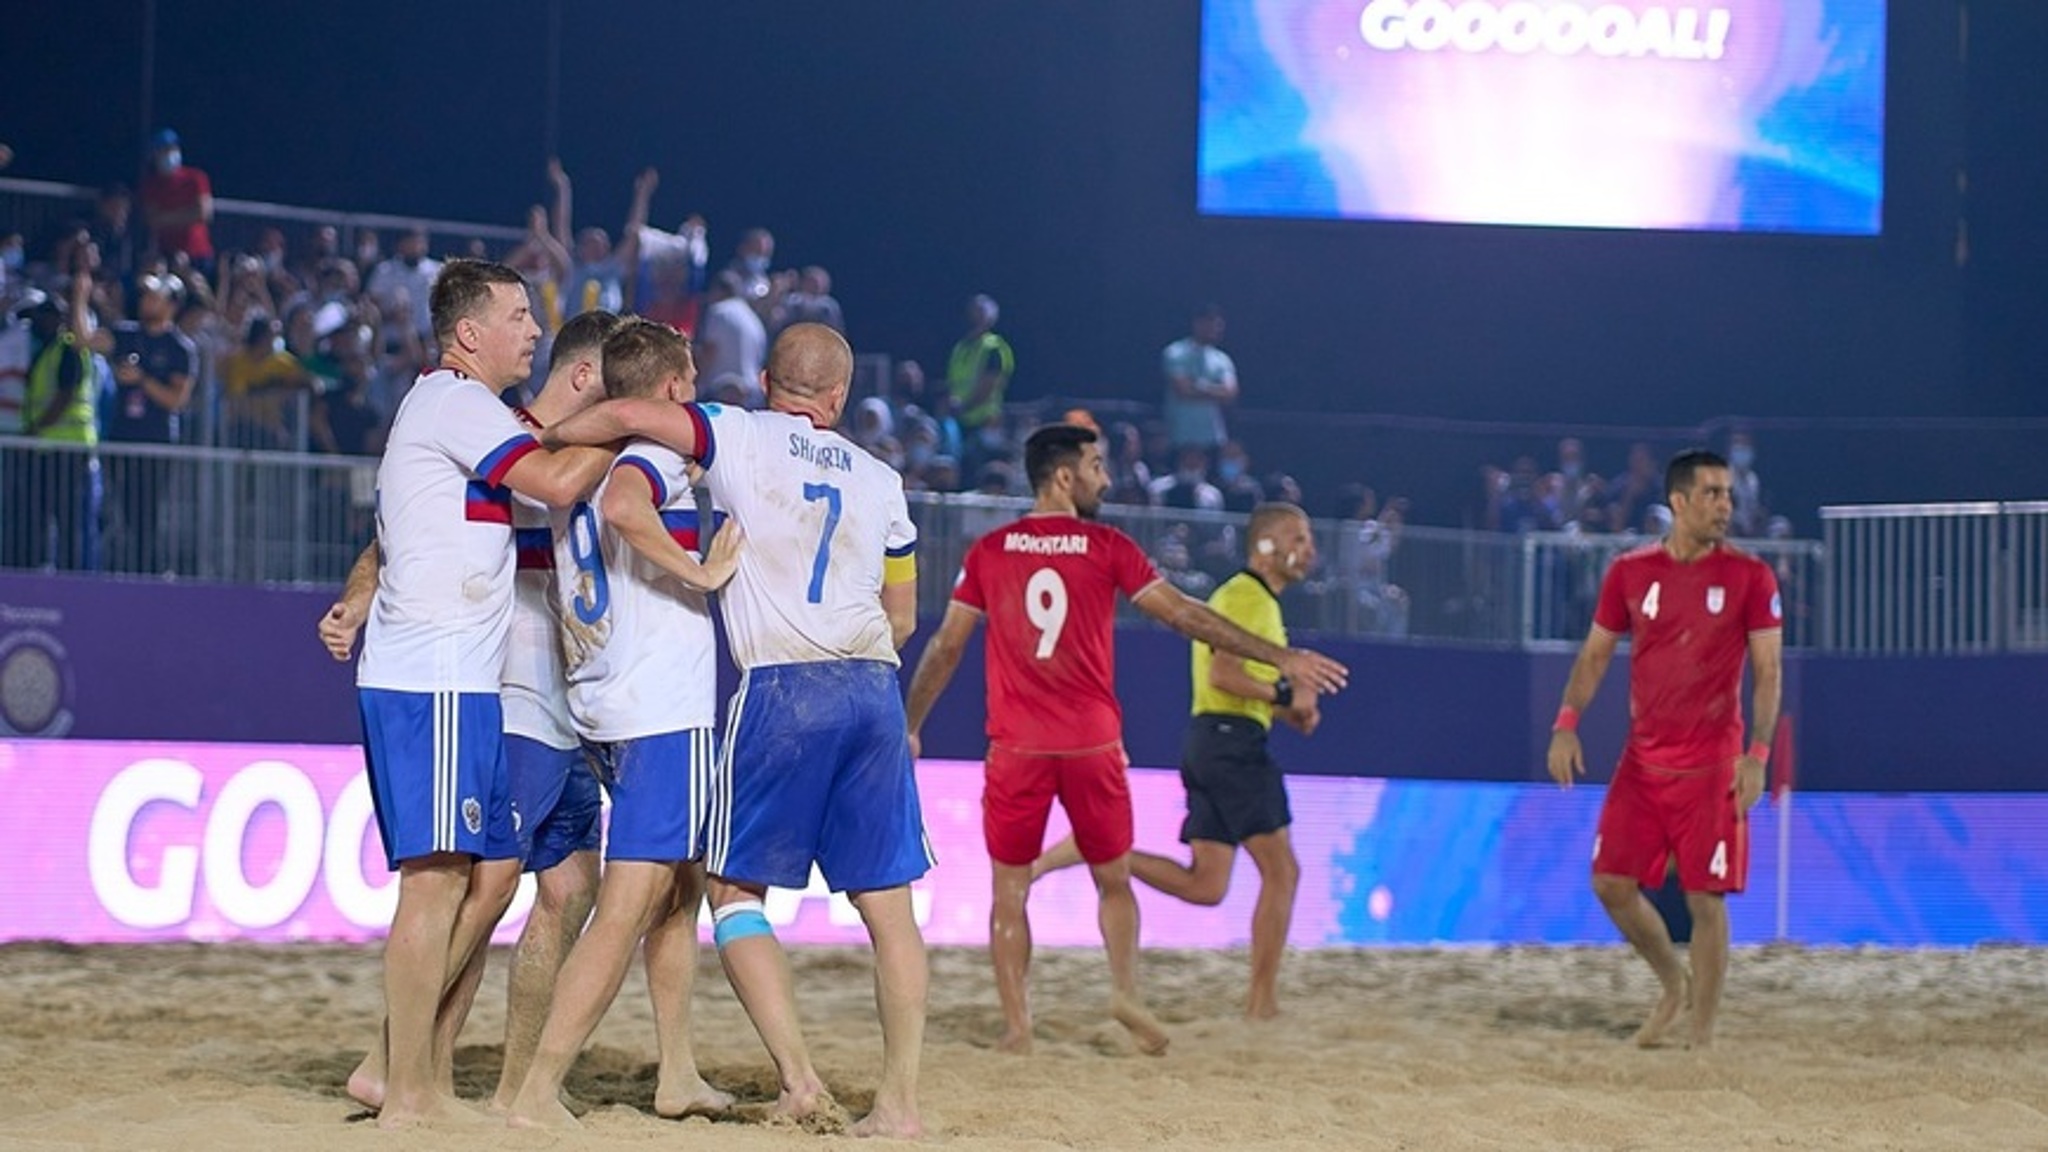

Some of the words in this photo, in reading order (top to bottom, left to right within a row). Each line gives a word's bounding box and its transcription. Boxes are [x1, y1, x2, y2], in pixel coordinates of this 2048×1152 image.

[1360, 0, 1730, 60] GOOOOOAL!
[568, 500, 609, 625] 9
[803, 482, 842, 604] 7
[1003, 532, 1089, 556] MOKHTARI
[1025, 566, 1069, 660] 9
[1641, 580, 1661, 621] 4
[1709, 839, 1728, 880] 4
